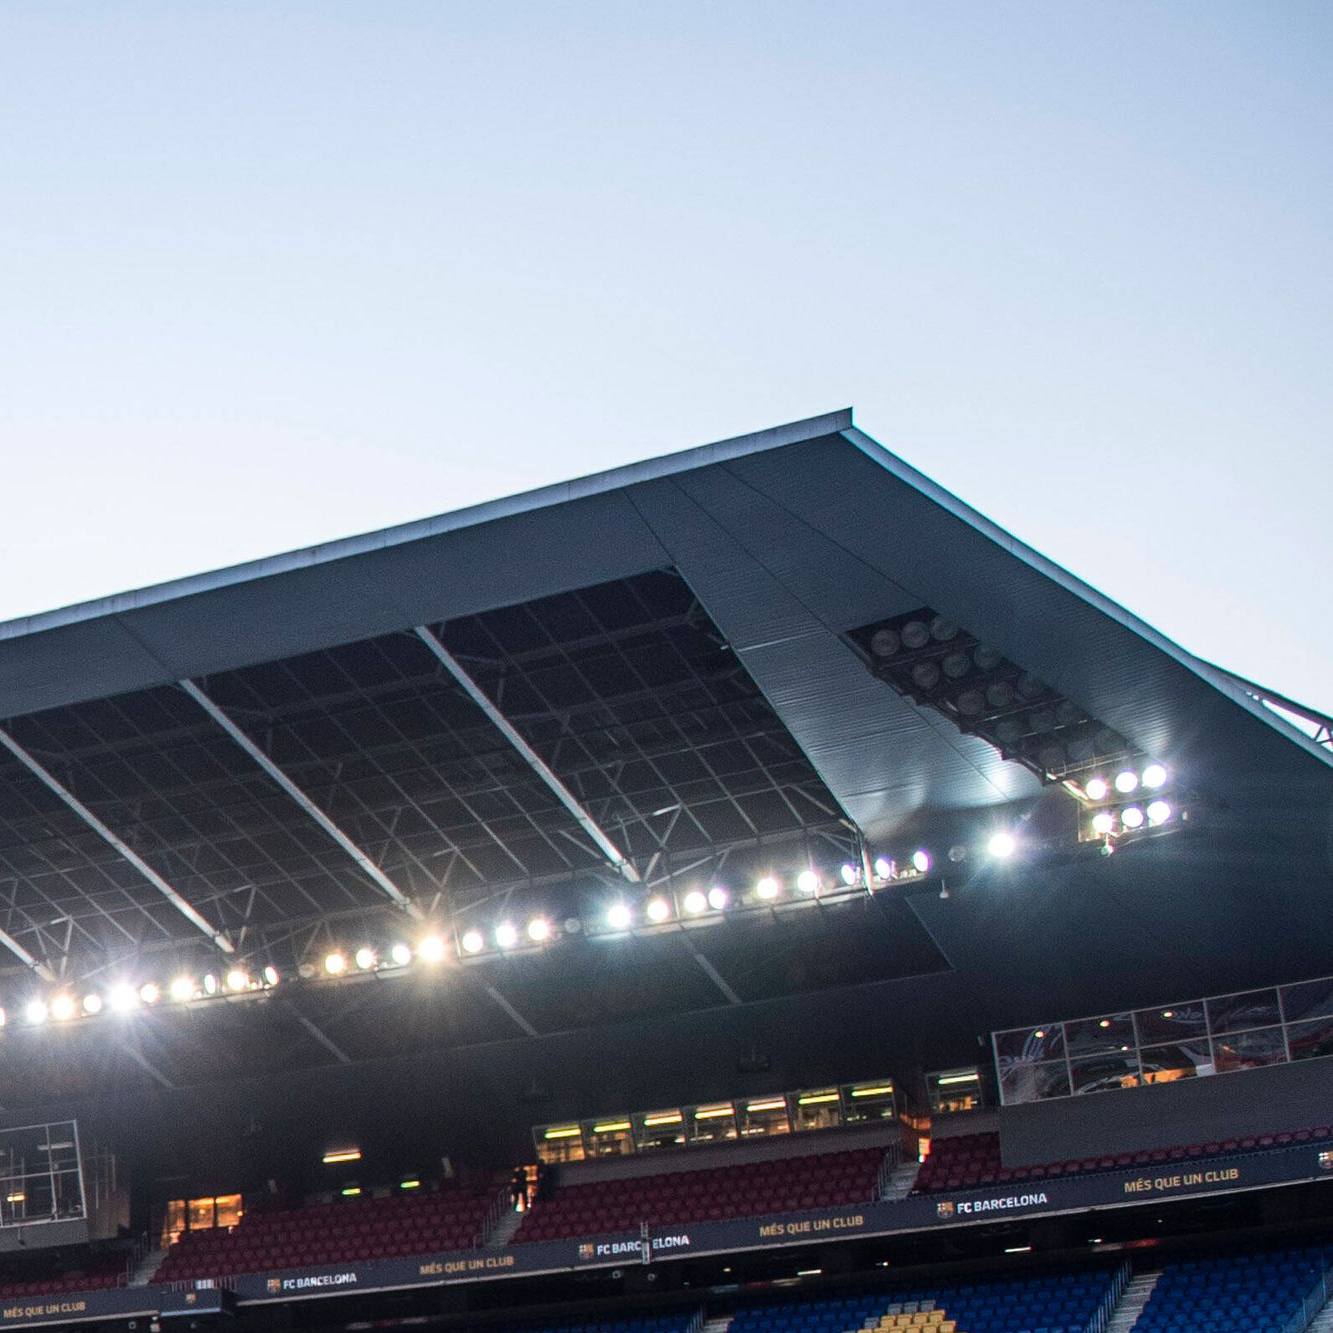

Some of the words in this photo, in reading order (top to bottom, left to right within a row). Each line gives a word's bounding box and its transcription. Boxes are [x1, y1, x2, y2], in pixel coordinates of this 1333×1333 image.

[1124, 1176, 1151, 1193] MÉS
[1155, 1174, 1180, 1190] QUE
[1184, 1172, 1202, 1187] UN
[1206, 1168, 1238, 1184] CLUB
[957, 1201, 972, 1214] FC
[974, 1193, 1046, 1212] BARCELONA
[760, 1221, 785, 1238] MÉS
[788, 1220, 811, 1235] QUE
[815, 1218, 831, 1232] UN
[834, 1215, 864, 1228] CLUB
[597, 1244, 610, 1255] FC
[612, 1235, 690, 1254] BARCELONA
[421, 1260, 443, 1275] MÉS
[446, 1259, 467, 1273] QUE
[470, 1258, 485, 1271] UN
[488, 1256, 514, 1269] CLUB
[283, 1278, 295, 1291] FC
[297, 1272, 357, 1288] BARCELONA
[4, 1306, 23, 1320] MÉS
[26, 1305, 44, 1318] QUE
[47, 1304, 60, 1316] UN
[62, 1302, 85, 1315] CLUB
